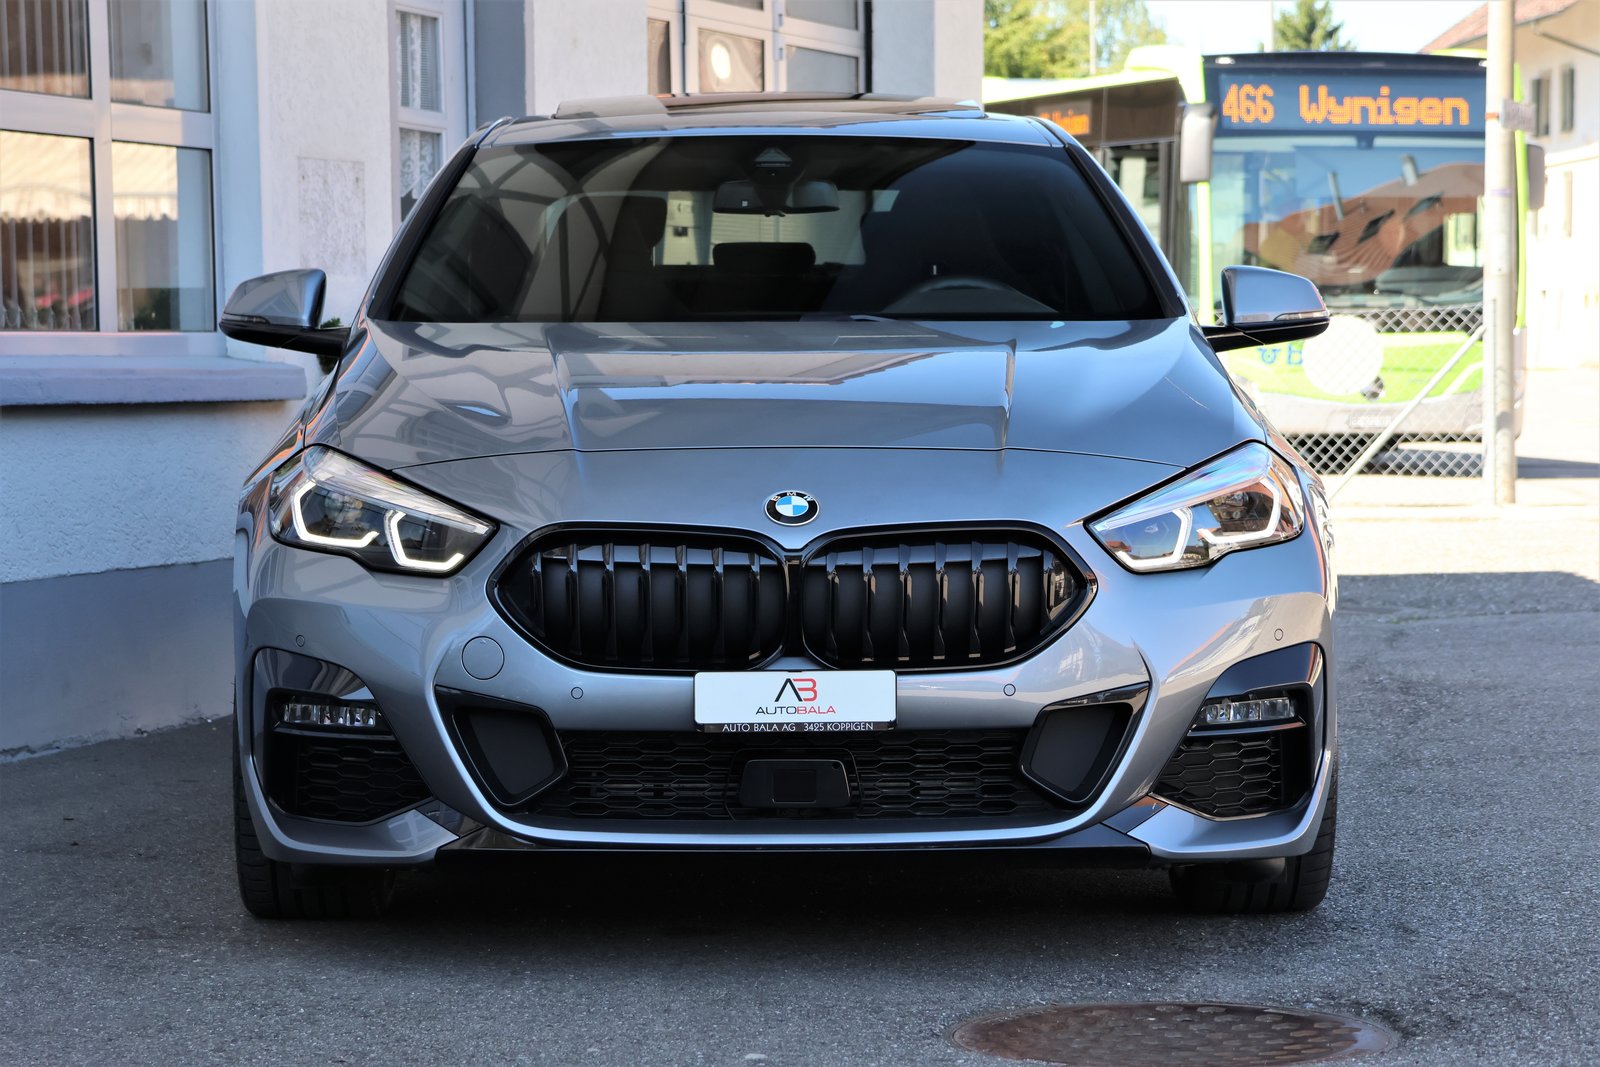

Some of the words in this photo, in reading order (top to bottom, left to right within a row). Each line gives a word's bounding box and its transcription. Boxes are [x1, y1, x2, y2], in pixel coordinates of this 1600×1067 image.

[1222, 83, 1275, 124] 466
[1299, 84, 1470, 126] Wynigen
[770, 491, 815, 502] BMW
[755, 705, 836, 715] AUTOBALA
[722, 723, 750, 732] AUTO
[753, 723, 779, 732] BALA
[781, 723, 796, 732] AG
[803, 722, 825, 732] 3425
[826, 721, 874, 732] KOPPIGEN
